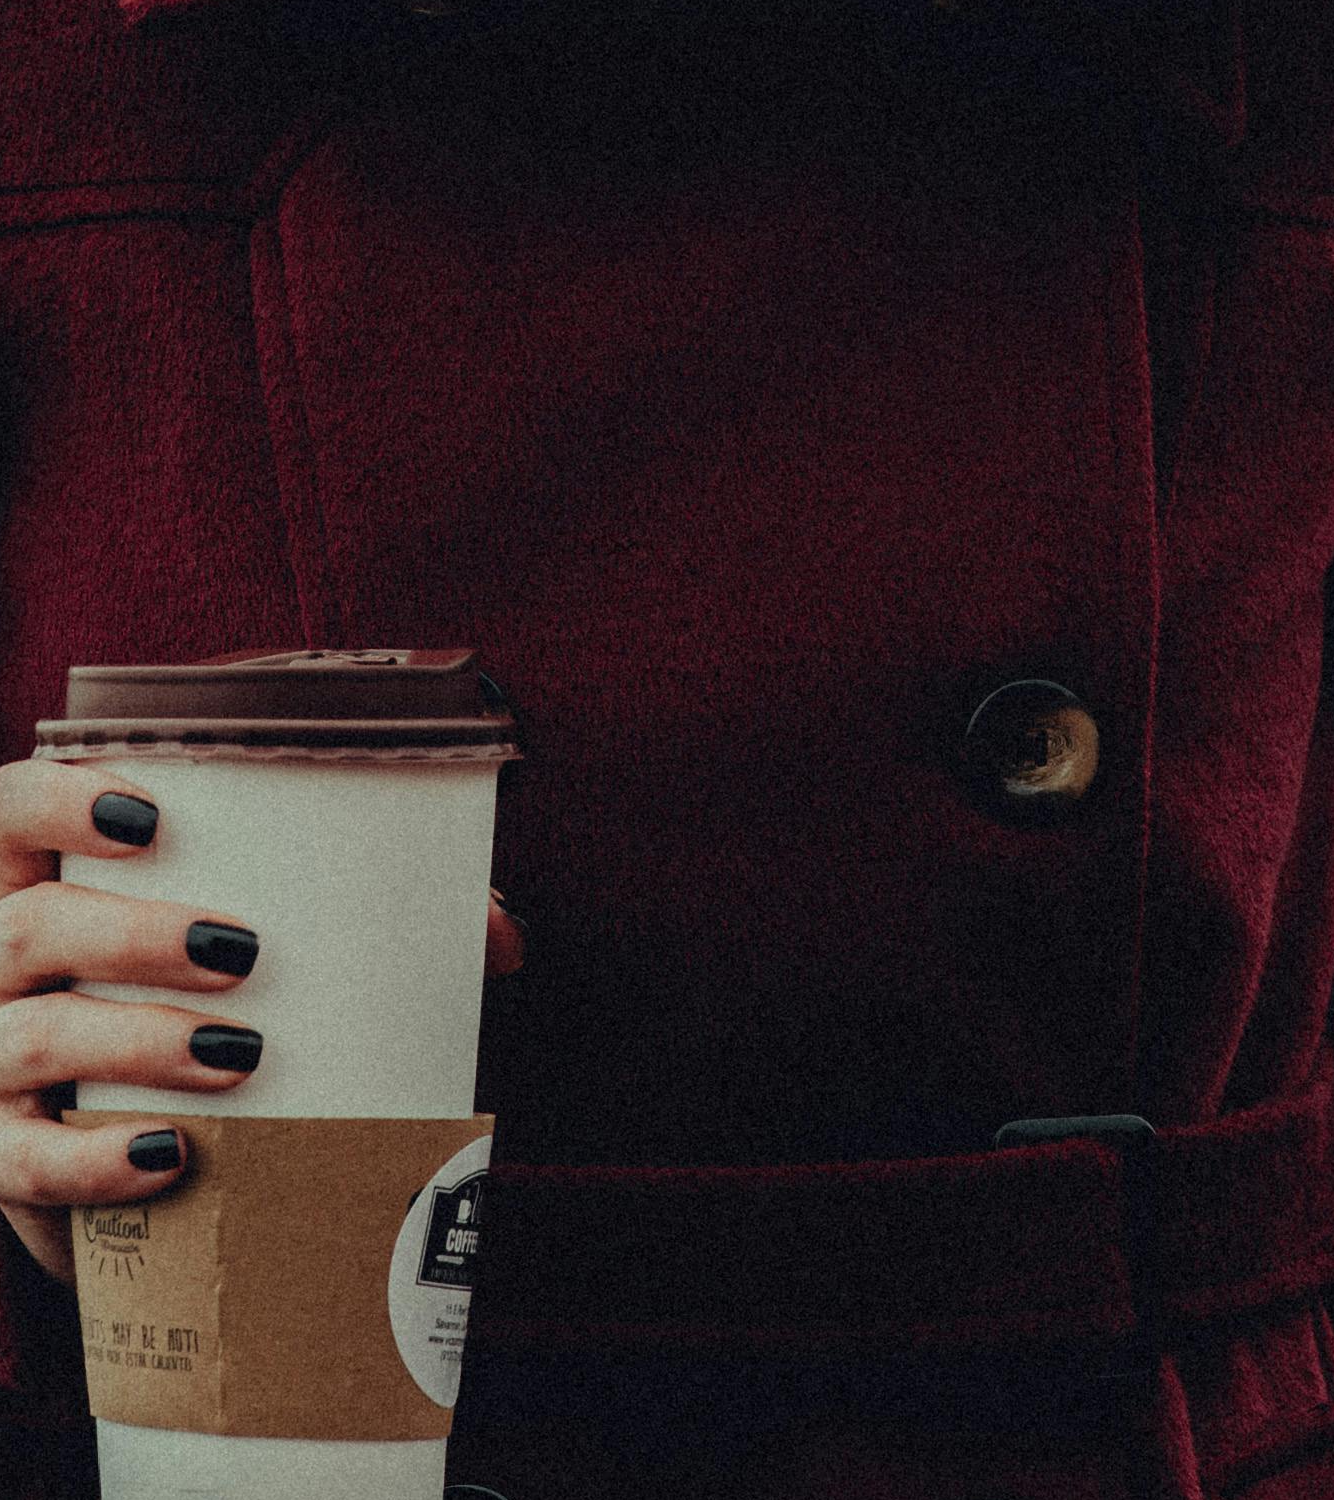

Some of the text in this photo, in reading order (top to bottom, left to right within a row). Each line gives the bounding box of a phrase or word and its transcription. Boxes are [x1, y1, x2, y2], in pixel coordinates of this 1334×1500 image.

[84, 1207, 150, 1243] Caution!
[111, 1322, 130, 1347] MAY
[141, 1325, 155, 1350] BE
[167, 1327, 199, 1353] HOT!
